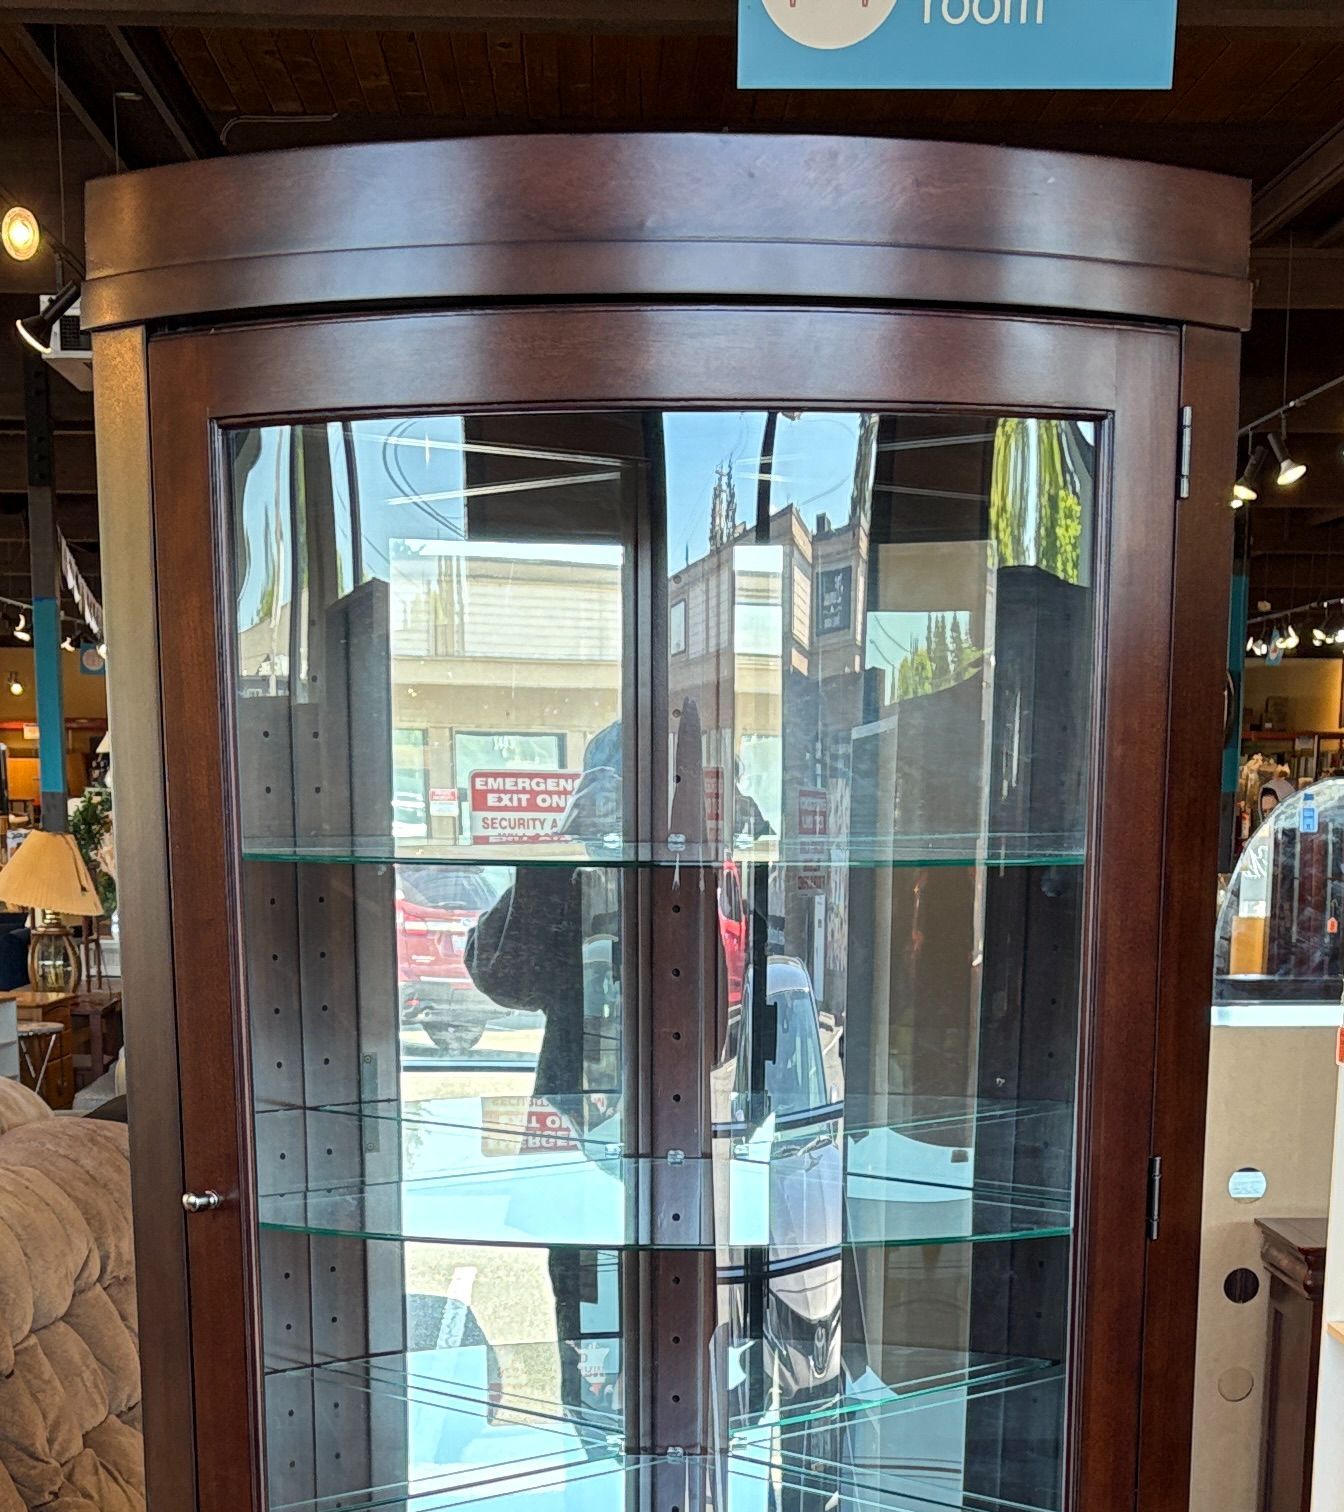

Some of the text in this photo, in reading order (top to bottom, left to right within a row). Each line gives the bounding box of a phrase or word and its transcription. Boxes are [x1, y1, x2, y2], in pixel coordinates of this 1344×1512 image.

[923, 0, 1044, 24] room
[475, 778, 582, 791] EMERGEN
[487, 793, 573, 808] EXIT ON
[481, 817, 546, 830] SECURITY
